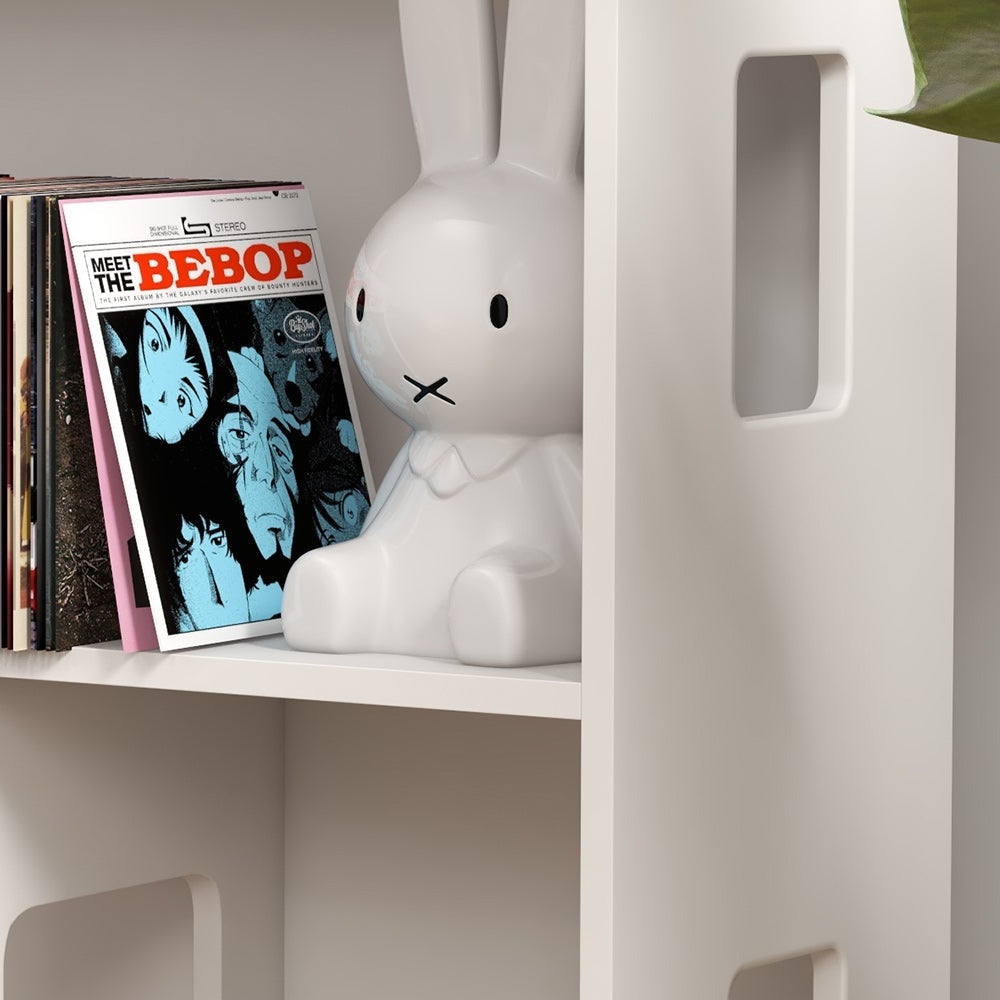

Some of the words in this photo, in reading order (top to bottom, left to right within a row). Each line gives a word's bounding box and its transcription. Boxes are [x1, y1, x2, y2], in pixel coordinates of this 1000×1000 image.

[215, 221, 247, 233] STEREO
[90, 255, 132, 273] MEET
[132, 241, 312, 291] BEBOP
[94, 272, 135, 293] THE
[114, 295, 131, 303] FIRST
[210, 285, 238, 294] FAVORITE
[267, 282, 290, 290] BOUNTY
[292, 280, 319, 288] HUNTERS
